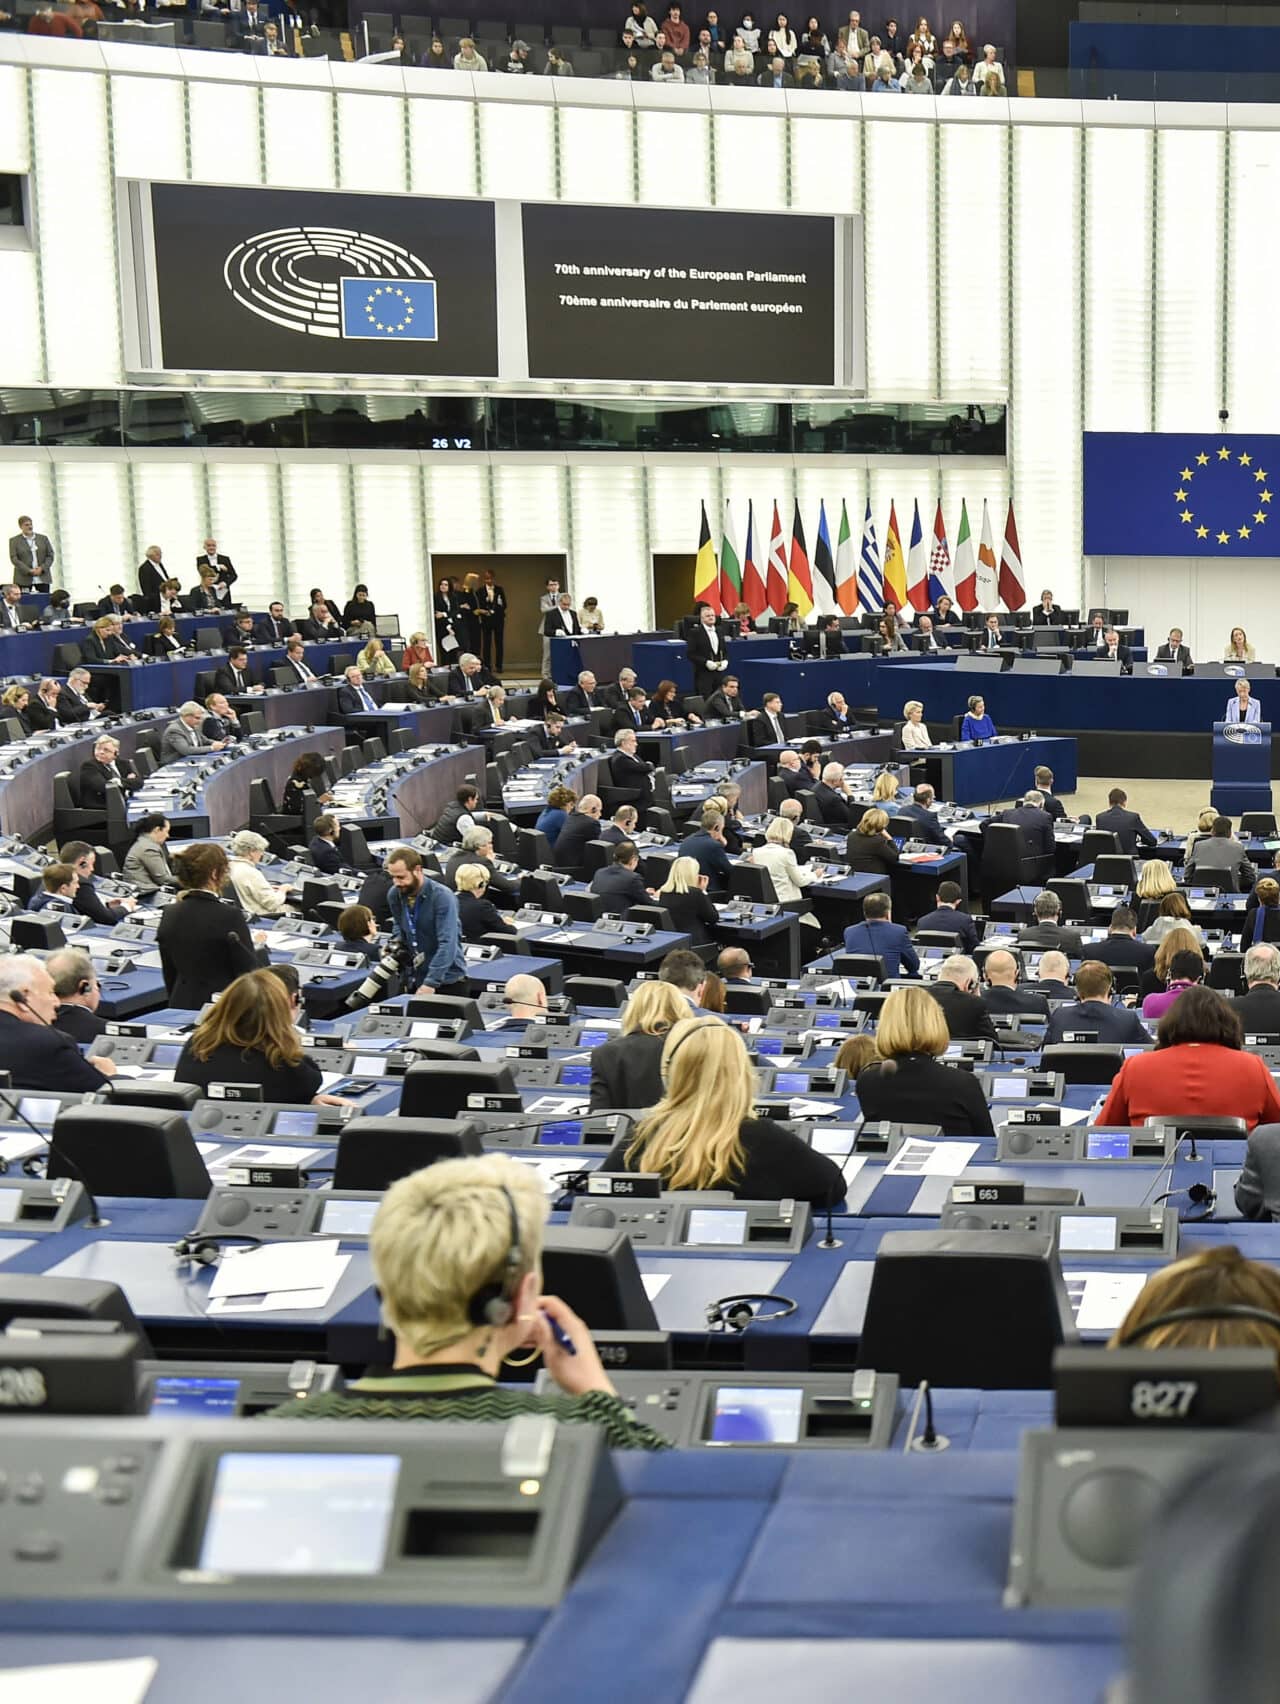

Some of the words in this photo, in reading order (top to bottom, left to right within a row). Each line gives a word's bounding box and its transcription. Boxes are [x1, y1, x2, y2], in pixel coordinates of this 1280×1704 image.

[554, 263, 581, 275] 70th
[583, 265, 651, 279] anniversary
[653, 268, 666, 278] of
[668, 268, 687, 279] the
[689, 268, 744, 282] European
[746, 270, 807, 283] Parliament
[559, 294, 598, 307] 70ème
[599, 296, 671, 309] anniversaire
[673, 298, 689, 310] du
[691, 299, 749, 312] Parlement
[750, 302, 803, 315] européen
[432, 438, 449, 449] 26
[454, 438, 472, 449] V2
[226, 1089, 241, 1098] 579
[755, 1107, 771, 1118] 577
[1026, 1113, 1041, 1122] 576
[251, 1171, 273, 1183] 665
[613, 1180, 634, 1194] 664
[978, 1189, 999, 1201] 663
[1131, 1380, 1198, 1418] 827
